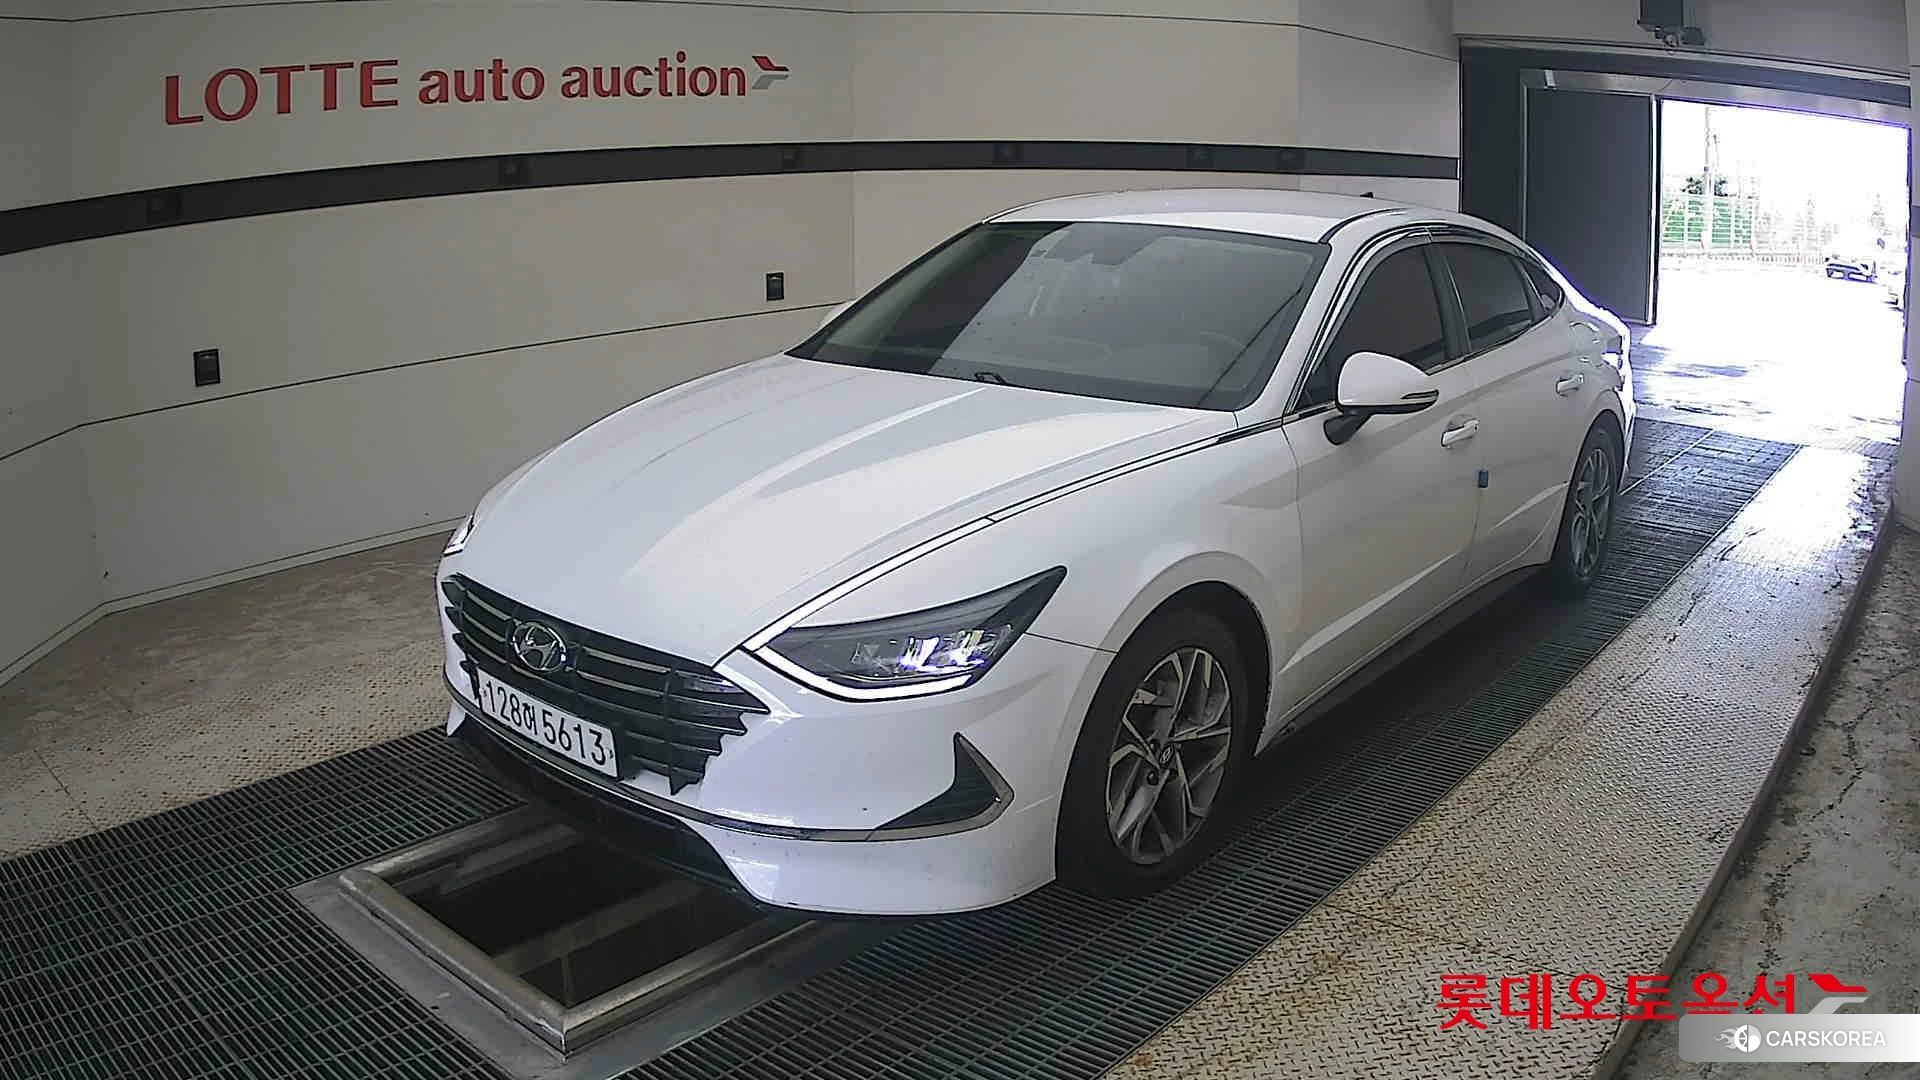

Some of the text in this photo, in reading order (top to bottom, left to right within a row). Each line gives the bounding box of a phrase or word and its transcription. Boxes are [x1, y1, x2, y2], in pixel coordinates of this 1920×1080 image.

[165, 51, 747, 125] LOTTE auto auction
